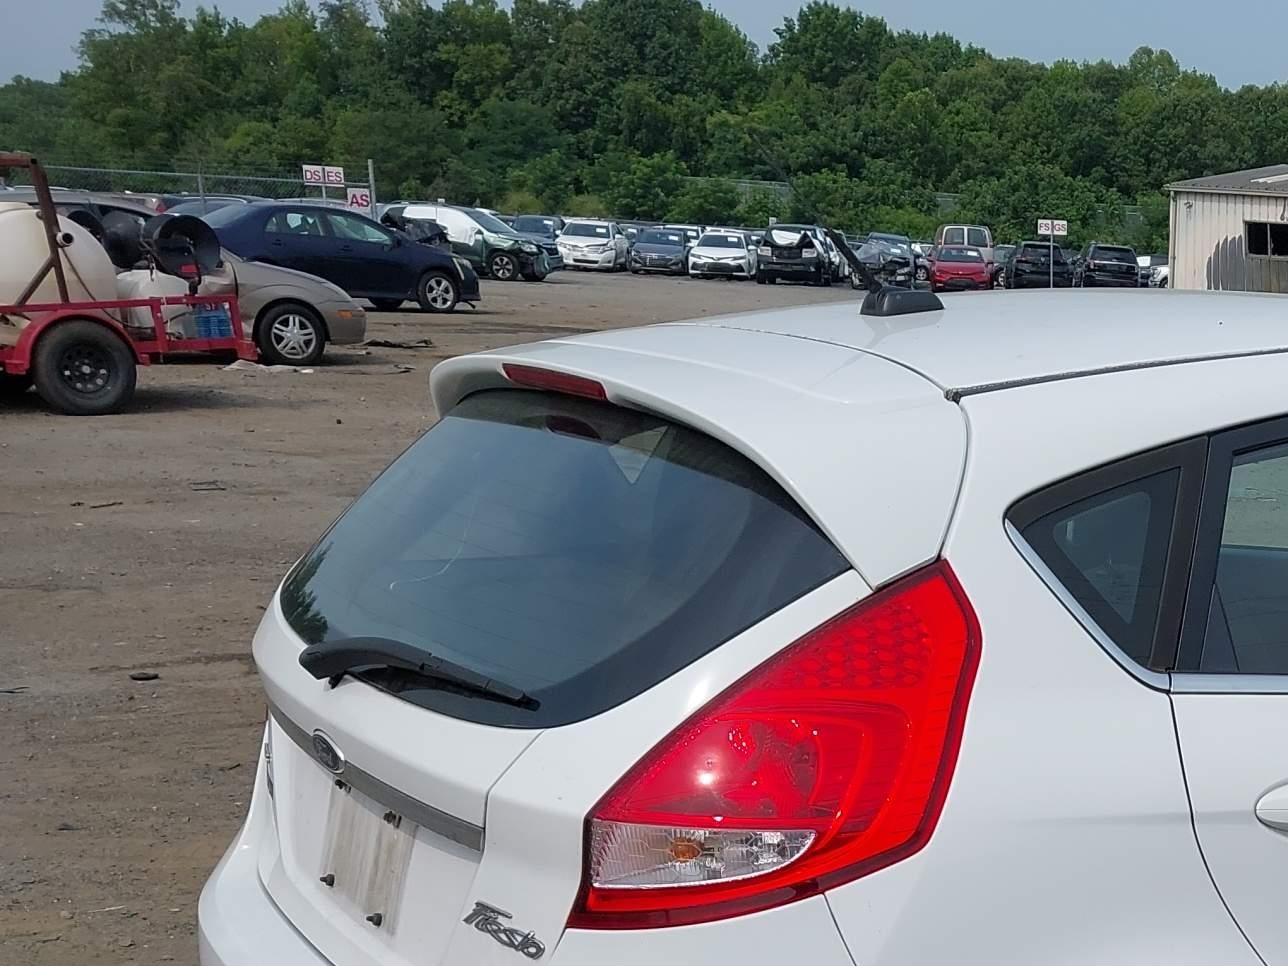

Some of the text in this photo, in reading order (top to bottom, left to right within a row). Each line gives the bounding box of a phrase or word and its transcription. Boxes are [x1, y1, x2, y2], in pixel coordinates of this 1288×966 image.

[304, 169, 321, 181] DS
[326, 171, 343, 182] ES
[350, 193, 370, 208] AS
[1039, 222, 1050, 232] FS
[1054, 223, 1067, 232] GS
